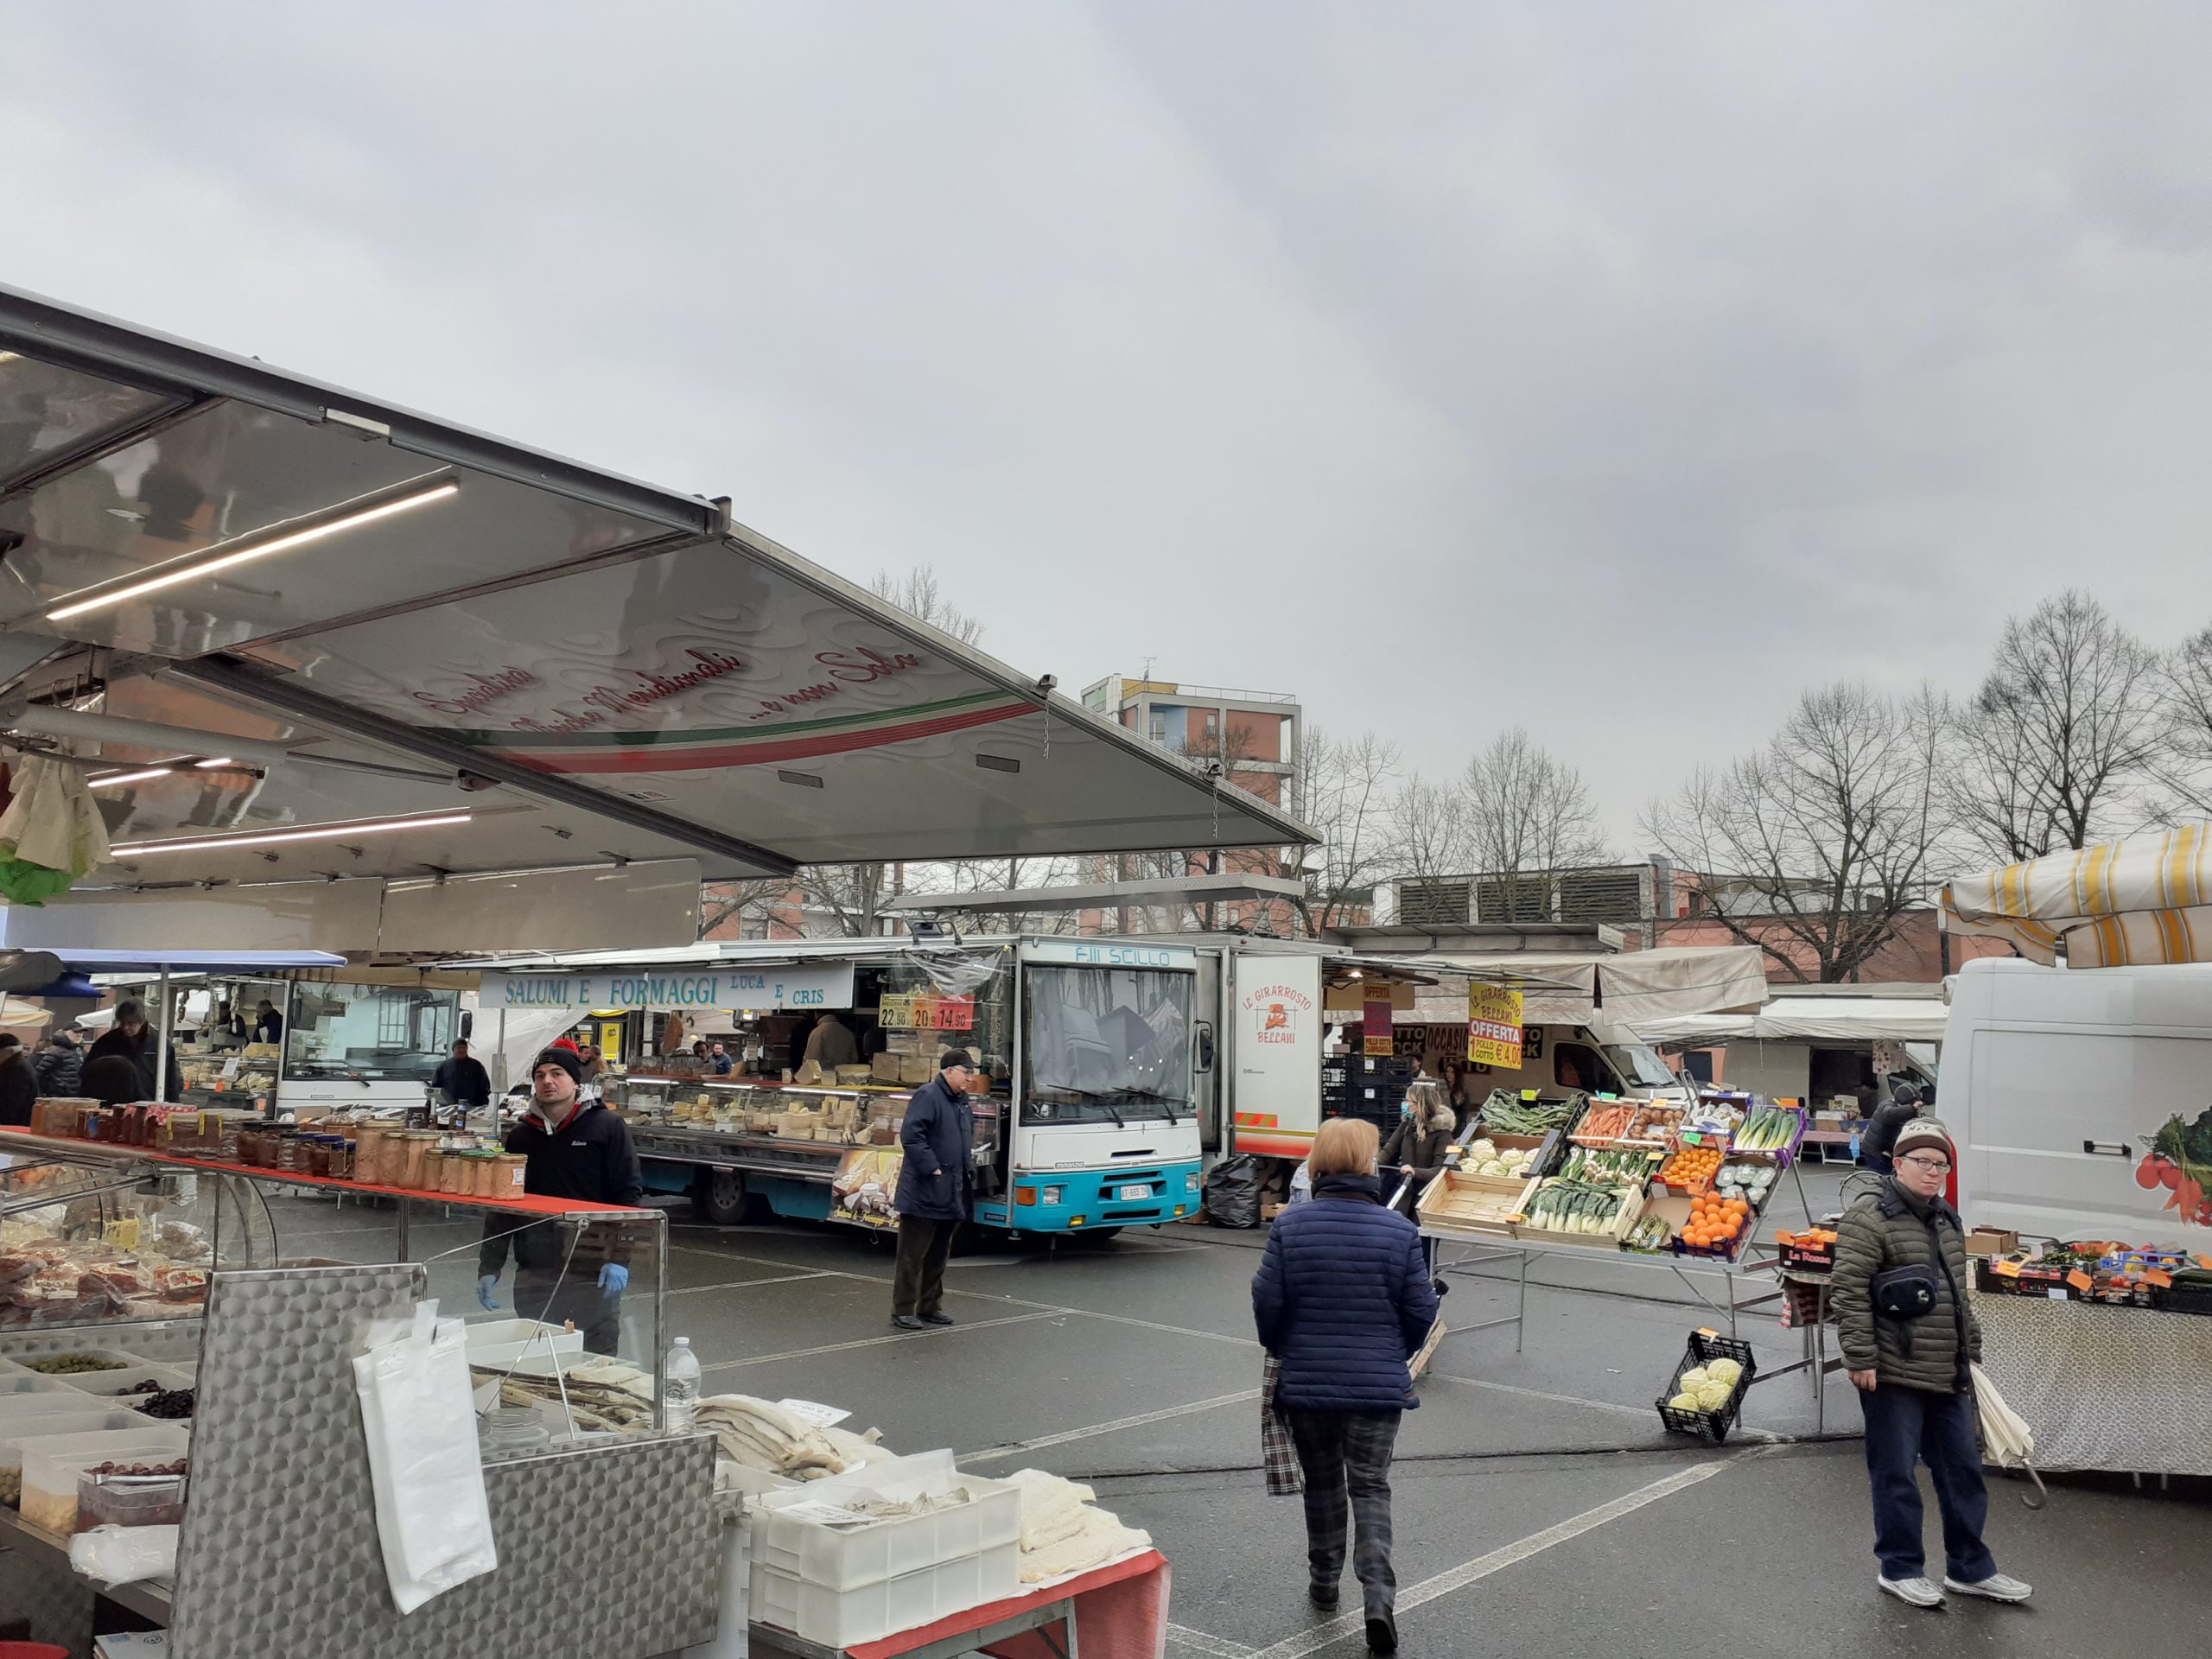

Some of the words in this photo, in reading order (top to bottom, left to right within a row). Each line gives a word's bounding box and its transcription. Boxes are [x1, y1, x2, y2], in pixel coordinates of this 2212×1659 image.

[815, 647, 918, 683] Solo
[1109, 949, 1170, 967] SCILLO
[505, 978, 569, 1004] SALUMI
[579, 979, 591, 1004] E
[609, 977, 719, 1004] FORMAGGI
[730, 975, 766, 989] LUCA
[775, 984, 784, 998] E
[792, 988, 824, 1005] CRIS
[1255, 985, 1312, 1011] GIRARROSTO
[1480, 988, 1521, 1018] GIRARROSTO
[1427, 1026, 1469, 1052] OCCASIO
[1471, 1020, 1521, 1044] OFFERTA
[1476, 1039, 1494, 1050] POLLO
[1475, 1049, 1494, 1060] COTTO
[1496, 1043, 1503, 1061] €
